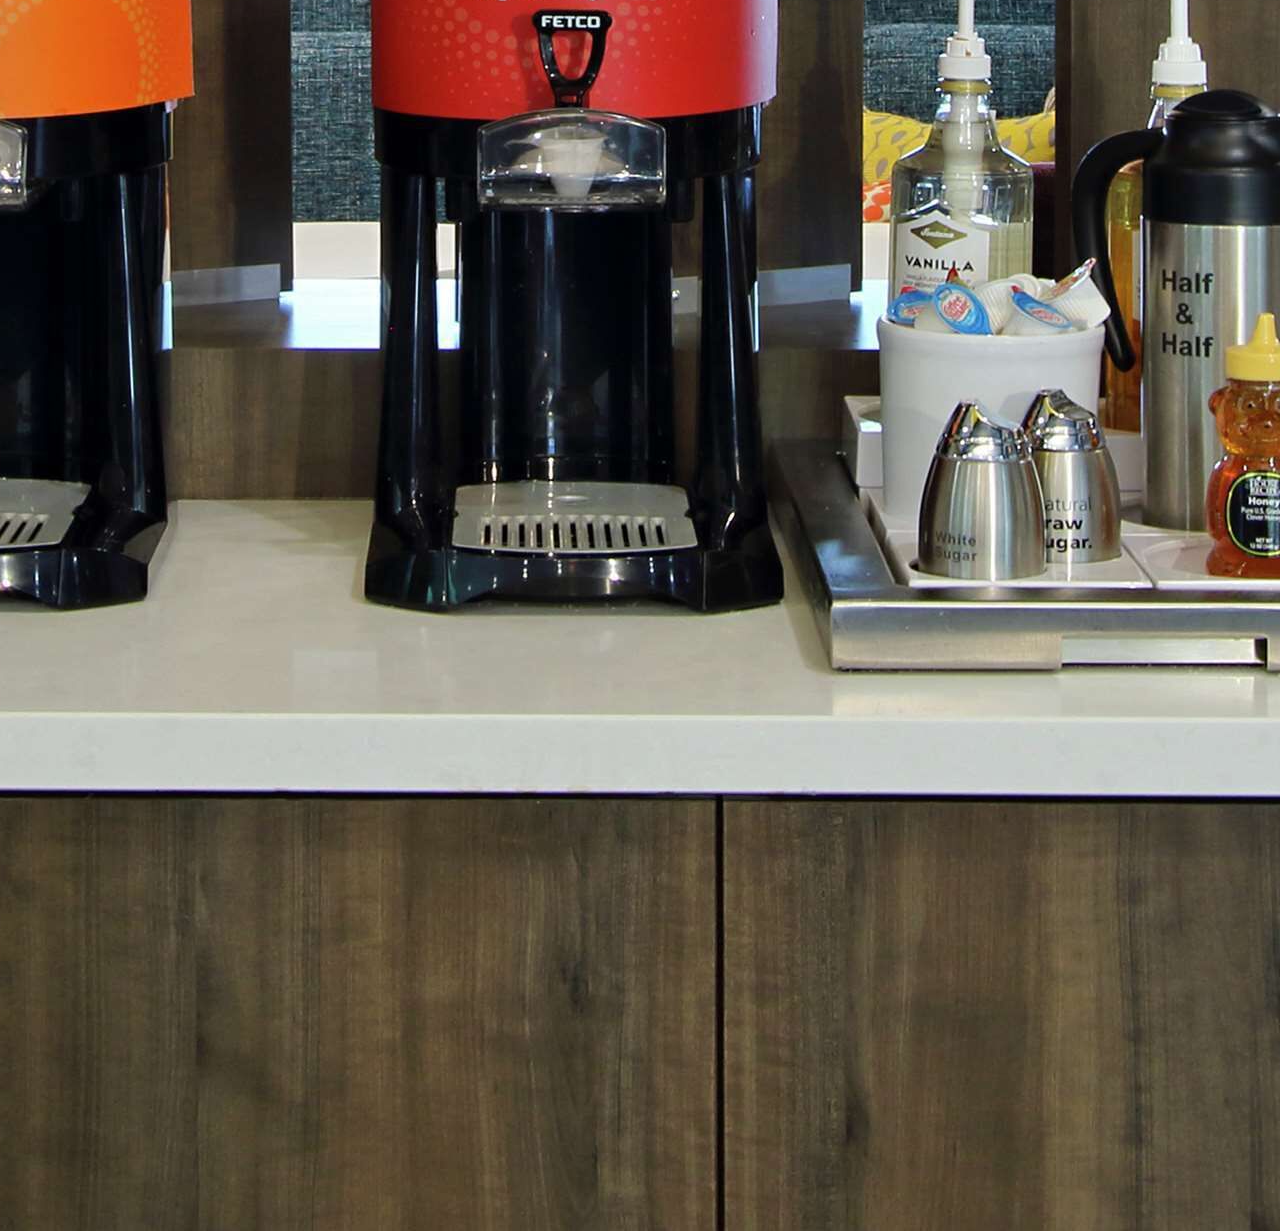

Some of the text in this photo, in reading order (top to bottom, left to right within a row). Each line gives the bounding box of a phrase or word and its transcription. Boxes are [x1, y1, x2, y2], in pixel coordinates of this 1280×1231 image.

[541, 15, 601, 29] FETCO
[905, 255, 975, 272] VANILLA
[1162, 269, 1214, 295] Half
[1176, 302, 1193, 325] &
[1162, 332, 1214, 357] Half
[1045, 495, 1092, 512] atural
[1045, 519, 1083, 531] raw
[935, 531, 977, 548] White
[1045, 536, 1093, 553] ugar.
[935, 546, 978, 563] Sugar
